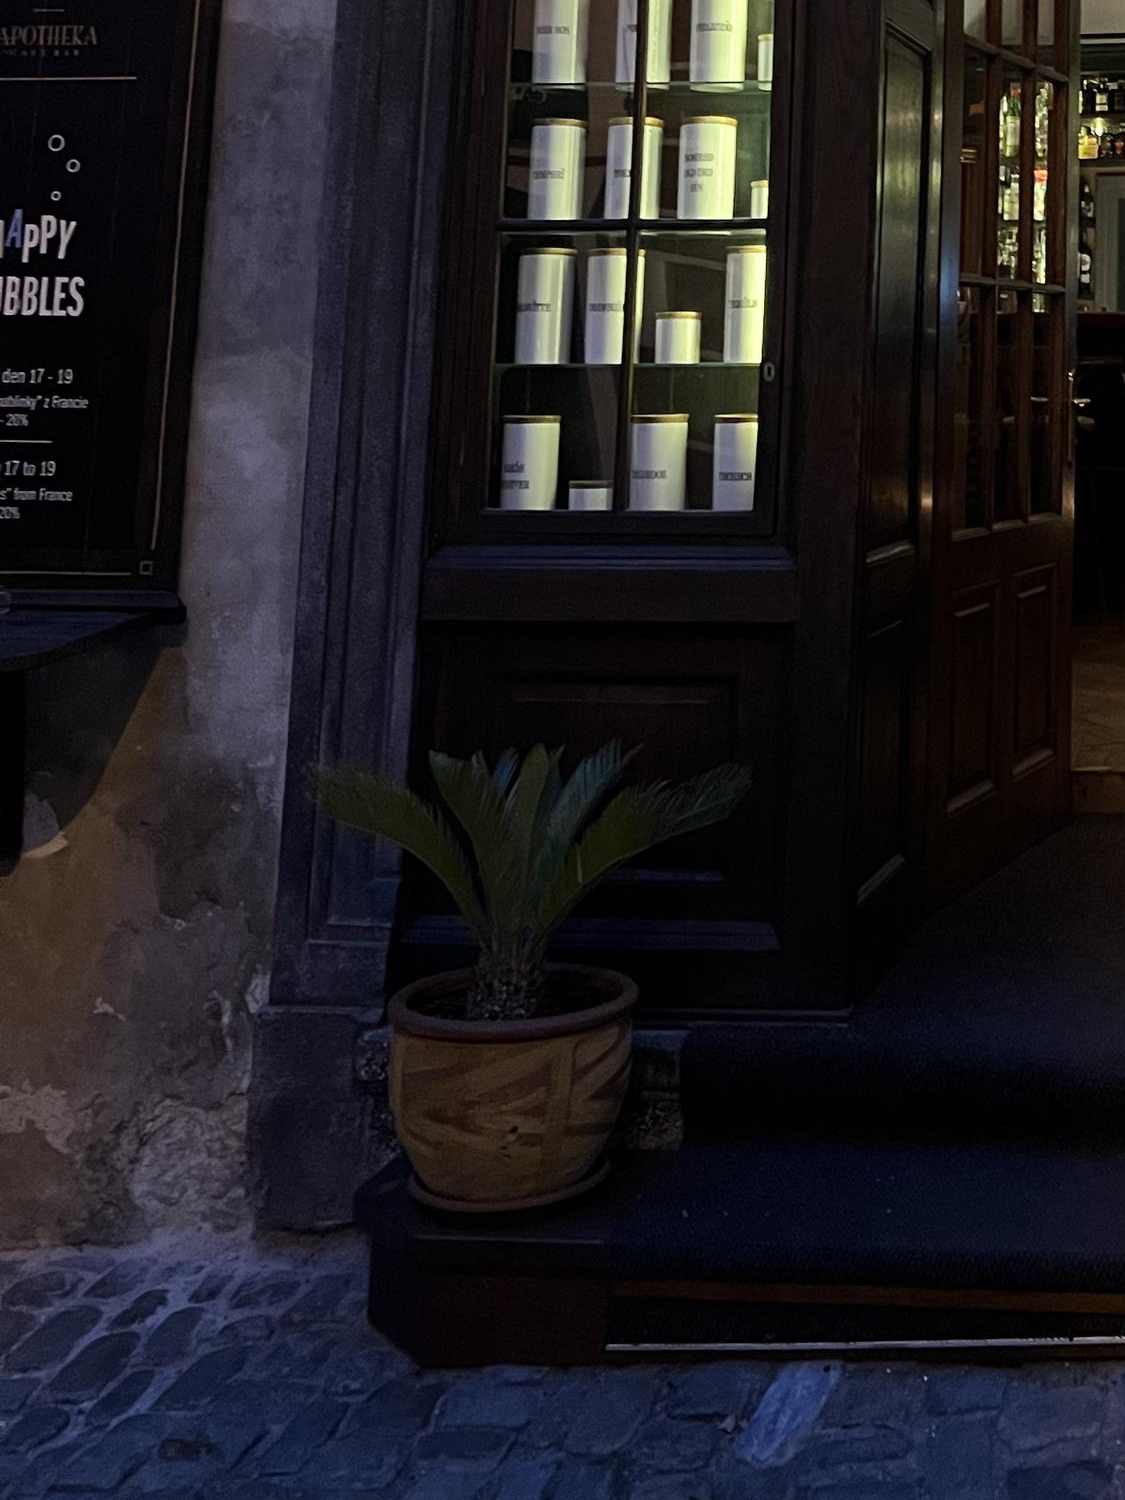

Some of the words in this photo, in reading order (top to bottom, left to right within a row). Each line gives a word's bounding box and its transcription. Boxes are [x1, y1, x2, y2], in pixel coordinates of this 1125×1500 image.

[0, 276, 85, 317] BBLES
[29, 368, 45, 384] 17
[57, 368, 74, 385] 19
[4, 460, 20, 476] 17
[39, 460, 56, 477] 19
